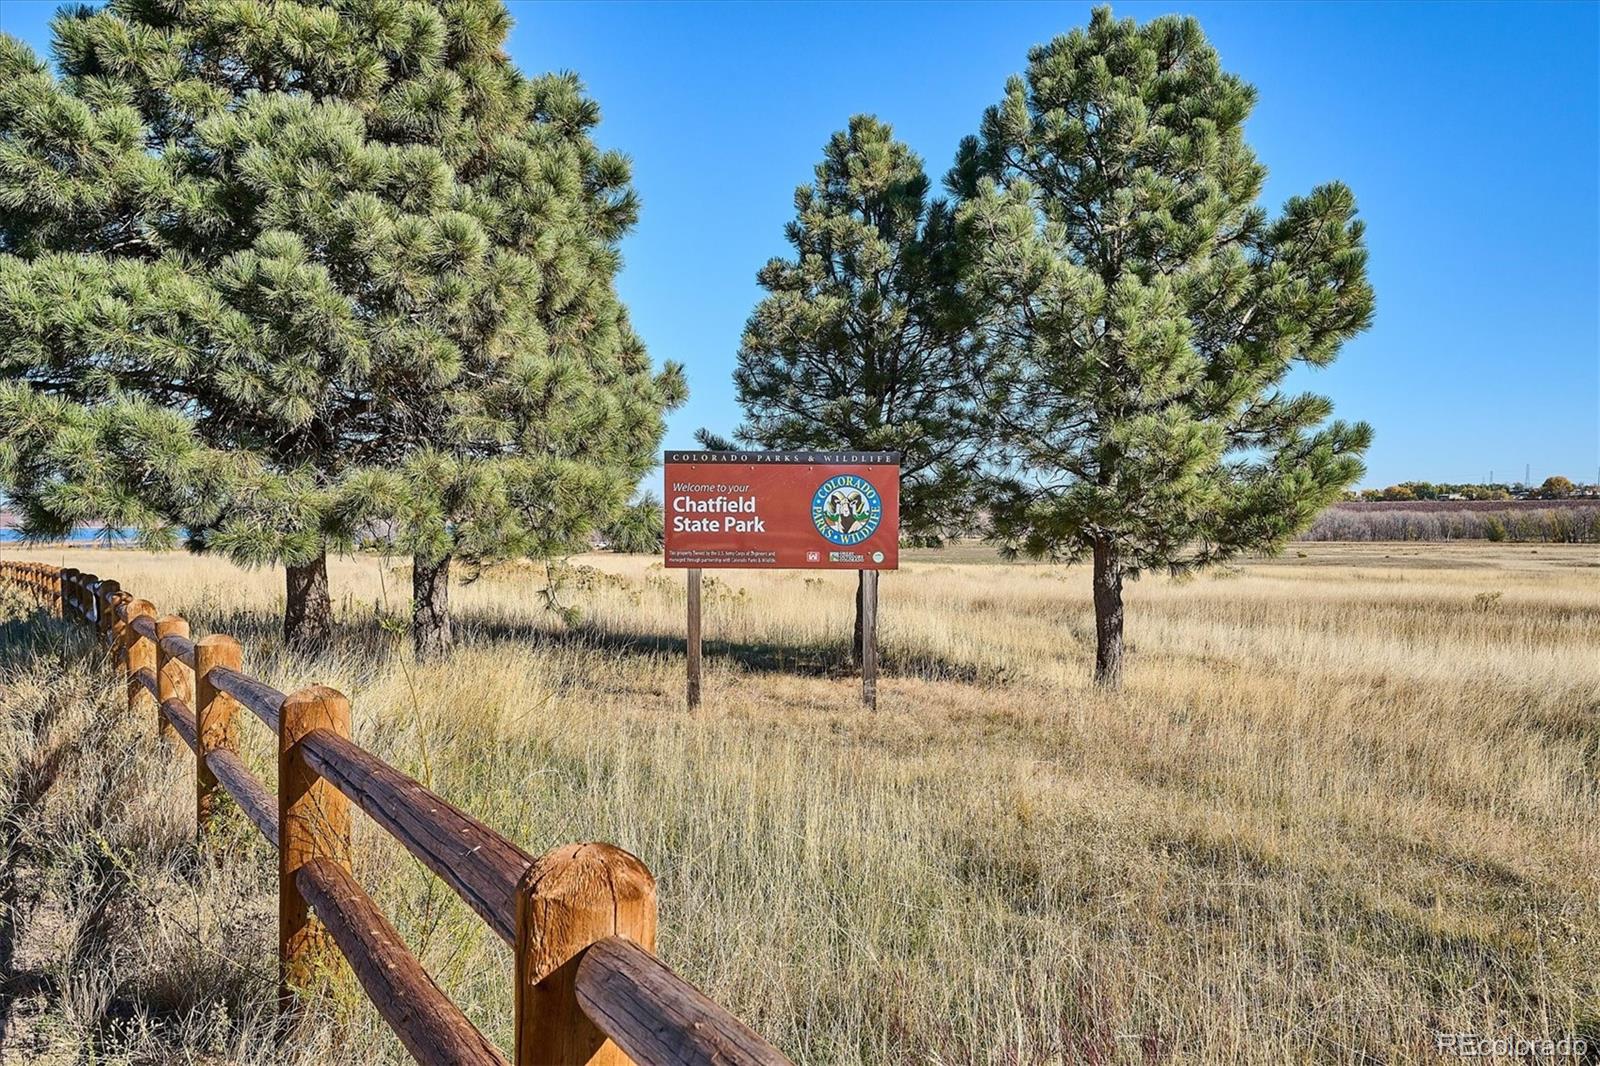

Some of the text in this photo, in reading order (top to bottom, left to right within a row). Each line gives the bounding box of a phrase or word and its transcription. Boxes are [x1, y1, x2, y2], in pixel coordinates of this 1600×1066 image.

[672, 454, 748, 462] COLORADO
[807, 455, 815, 463] &
[824, 455, 892, 463] WILDLIFE
[673, 482, 750, 495] Welcome to your
[817, 476, 876, 499] COLORADO
[672, 496, 756, 513] Chatfield
[673, 516, 766, 533] State Park
[812, 505, 881, 544] PARKS WILDLIFE
